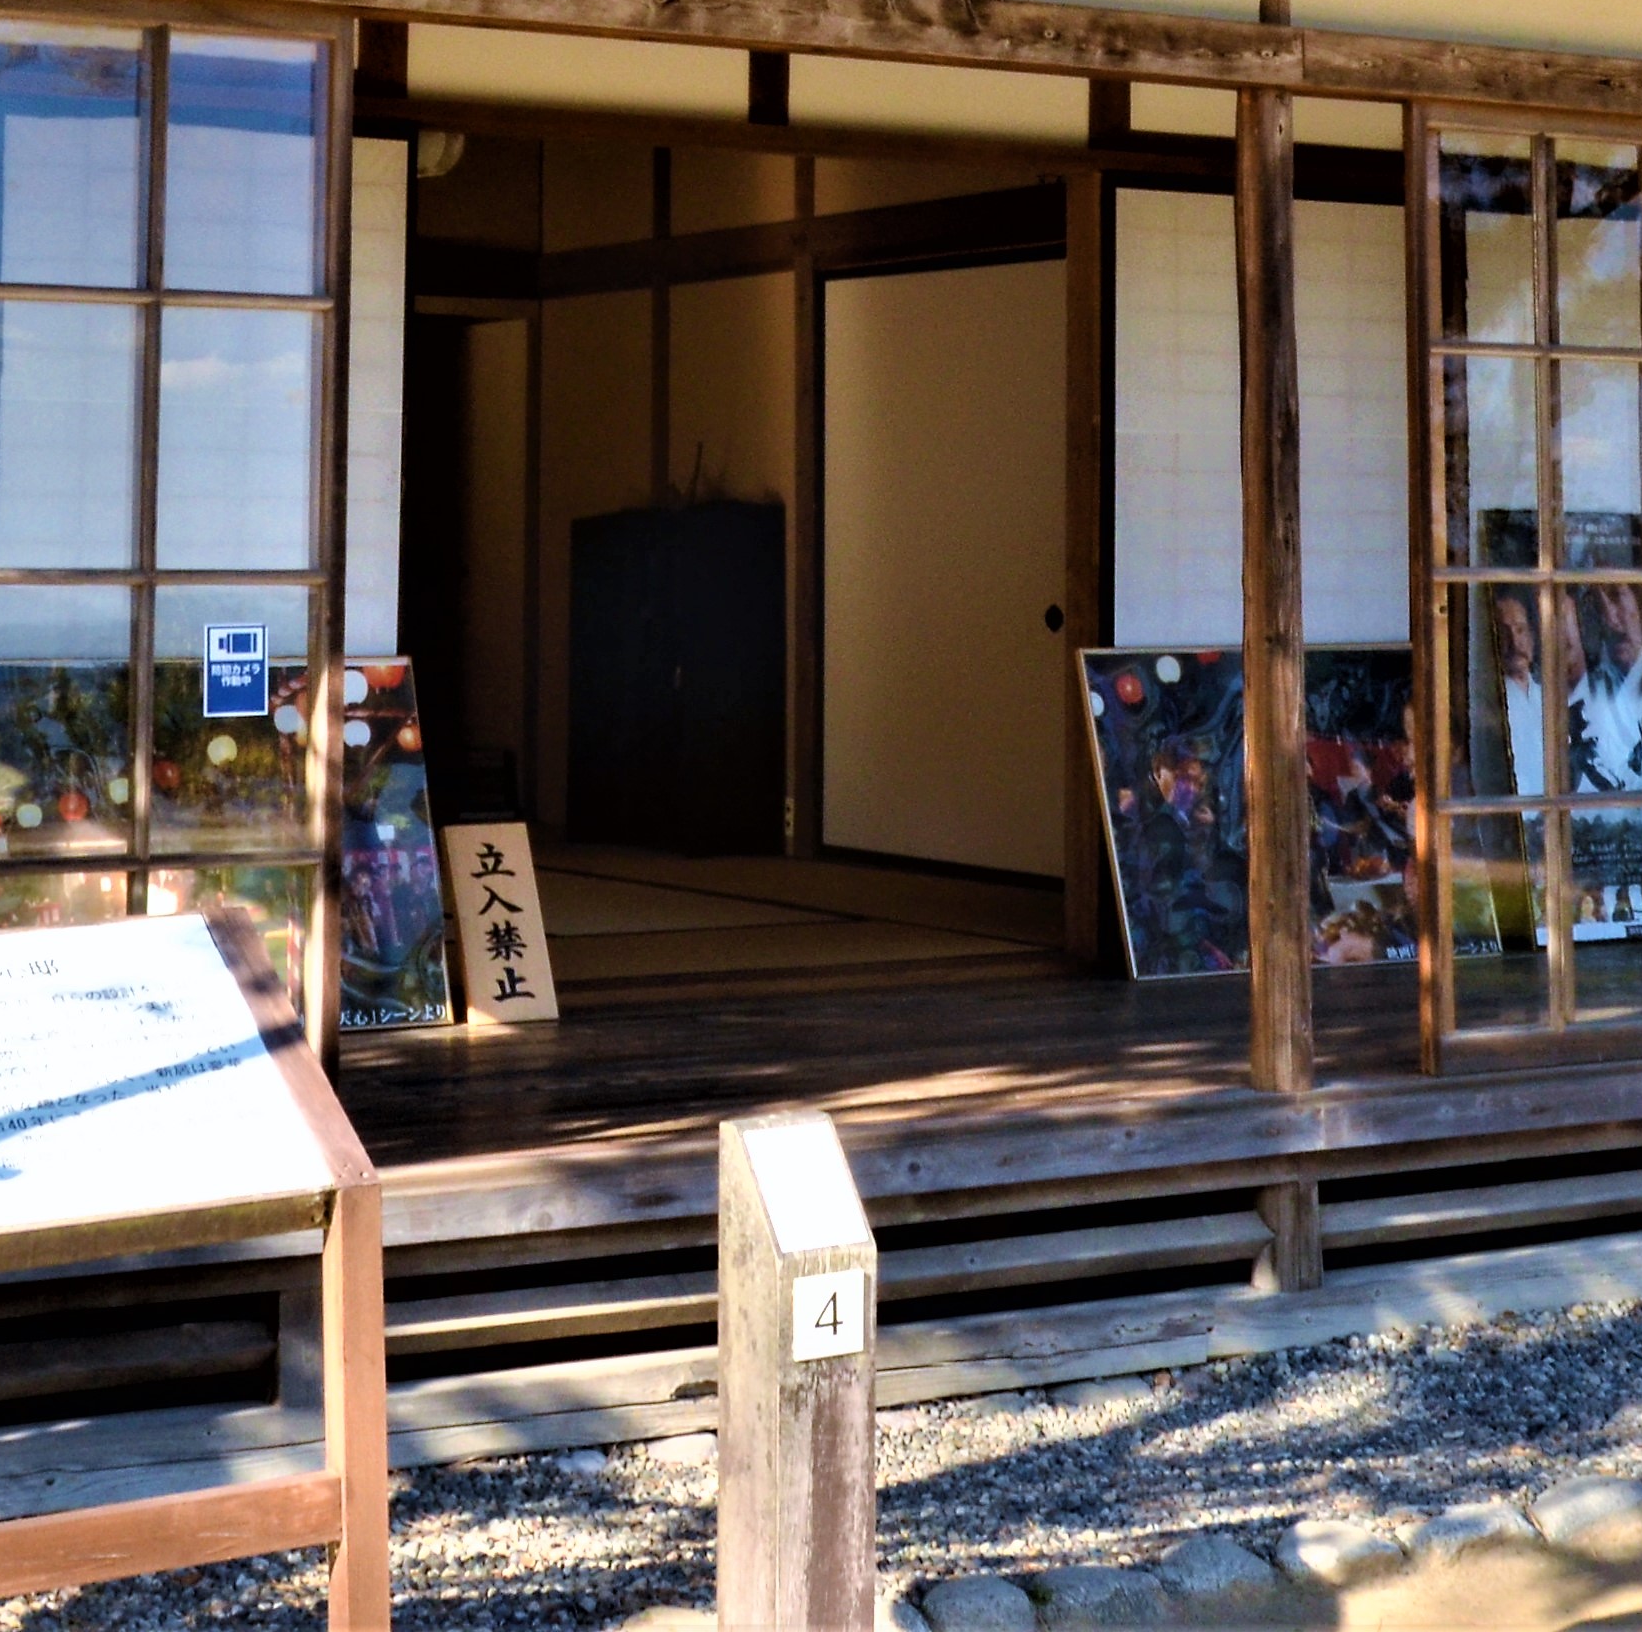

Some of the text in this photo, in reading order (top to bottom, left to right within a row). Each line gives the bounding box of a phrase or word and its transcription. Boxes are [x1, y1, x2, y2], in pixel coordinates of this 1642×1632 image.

[220, 675, 252, 688] 作動中
[470, 842, 536, 1003] 立入禁止
[814, 1291, 844, 1336] 4
